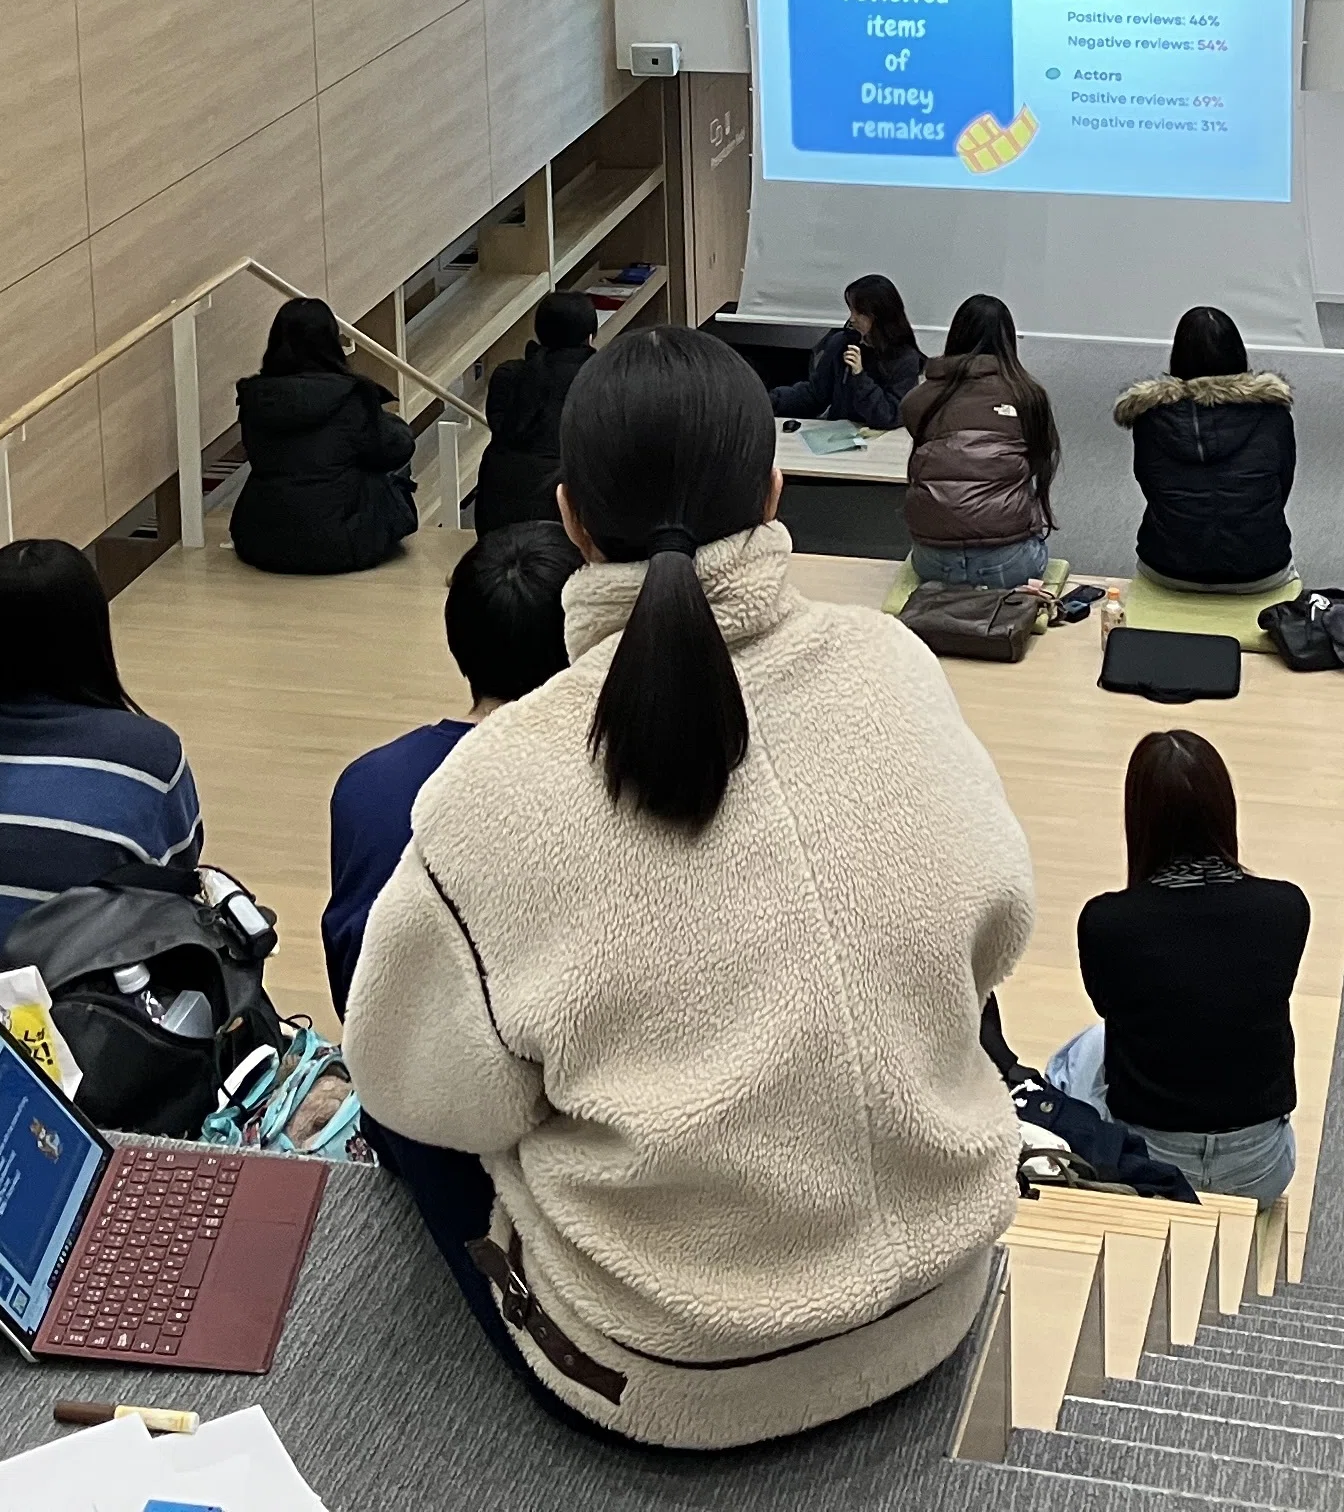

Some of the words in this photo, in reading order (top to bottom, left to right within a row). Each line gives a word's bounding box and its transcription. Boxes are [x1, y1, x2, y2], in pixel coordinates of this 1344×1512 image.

[866, 14, 927, 38] items
[1067, 11, 1123, 24] Positive
[1126, 13, 1186, 26] reviews:
[1189, 14, 1221, 27] 46%
[1067, 35, 1132, 50] Negative
[1135, 37, 1195, 51] reviews:
[1197, 39, 1228, 52] 54%
[884, 48, 911, 72] of
[1073, 69, 1123, 82] Actors
[860, 81, 934, 114] Disney
[1071, 91, 1127, 105] Positive
[1130, 93, 1189, 107] reviews:
[1192, 95, 1224, 108] 69%
[851, 118, 945, 141] remakes
[1071, 115, 1135, 131] Negative
[1138, 117, 1197, 132] reviews:
[1200, 119, 1229, 133] 31%
